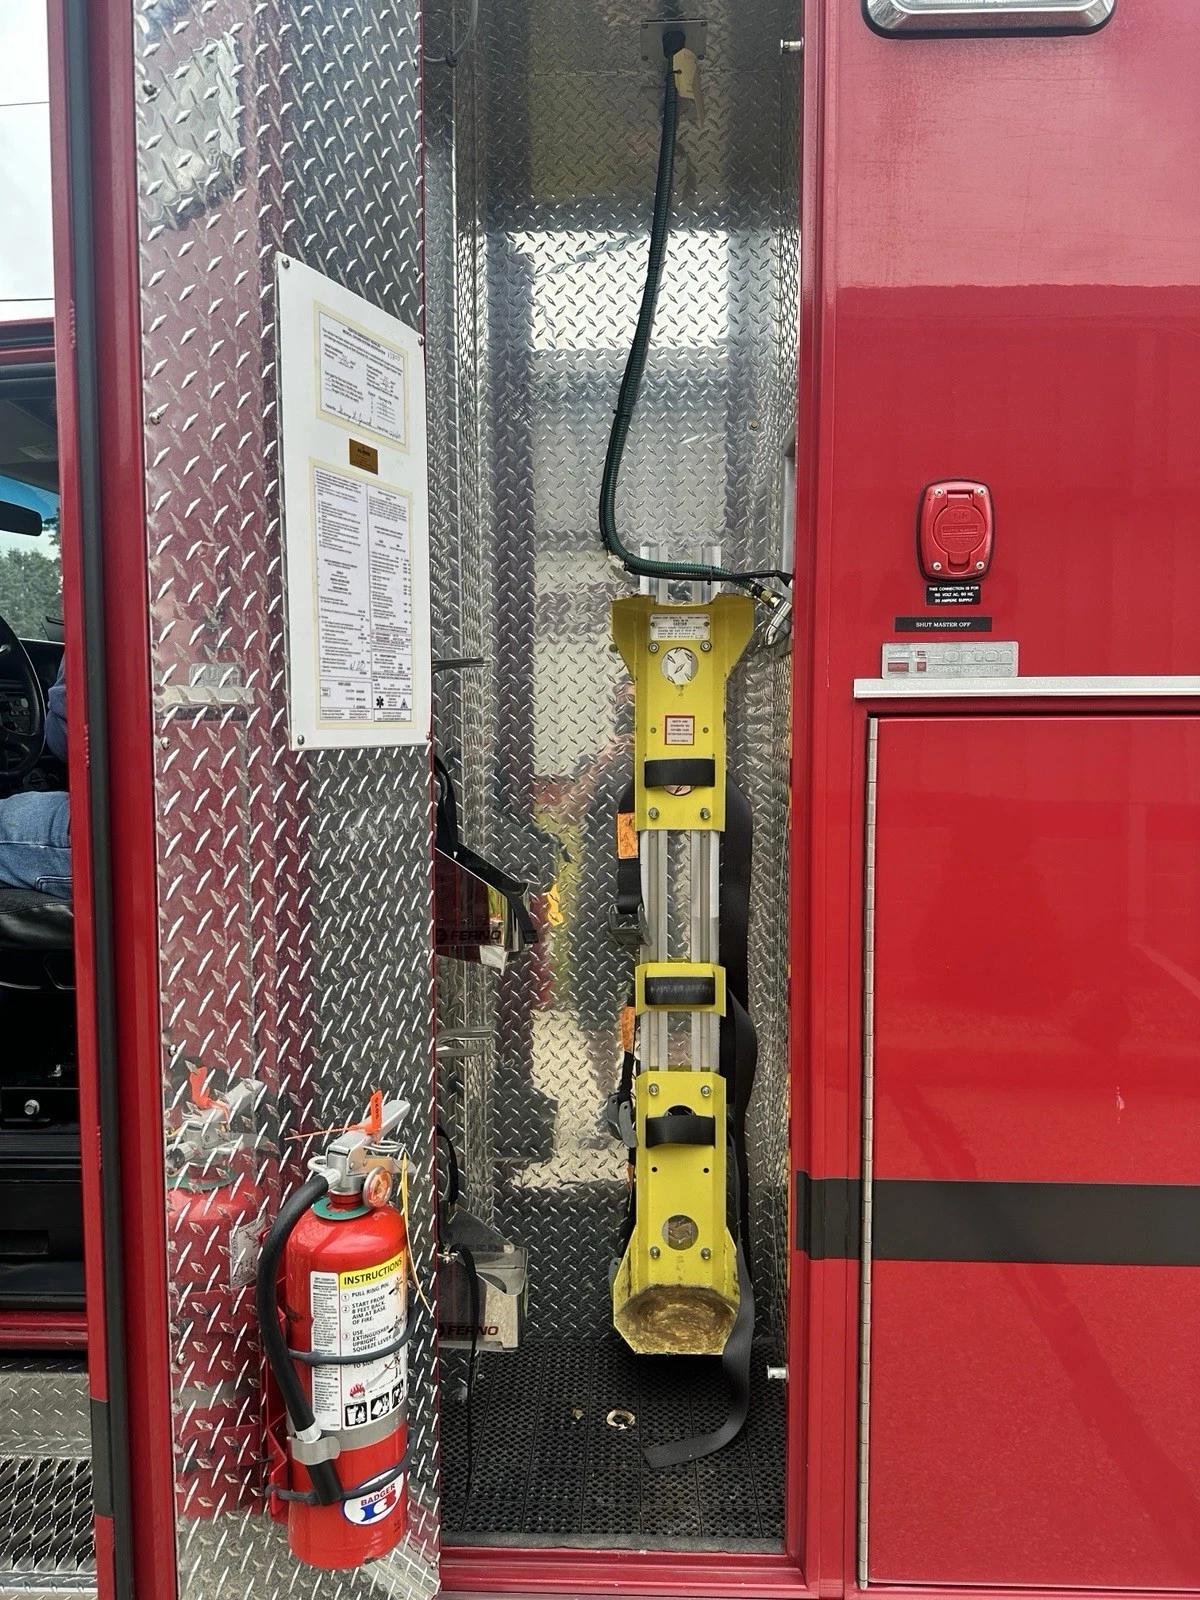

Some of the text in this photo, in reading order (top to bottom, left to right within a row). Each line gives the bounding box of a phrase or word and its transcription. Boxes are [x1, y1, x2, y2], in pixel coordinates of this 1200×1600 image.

[343, 1257, 402, 1285] INSTRUCTIONS
[366, 1286, 380, 1294] RING
[352, 1301, 369, 1309] START
[370, 1295, 385, 1304] FROM
[373, 1305, 386, 1314] BASE
[352, 1325, 389, 1341] EXTINGUISHER
[448, 1325, 499, 1336] FERNO
[352, 1342, 377, 1352] SQUEEZE
[360, 1483, 396, 1506] BADGER
